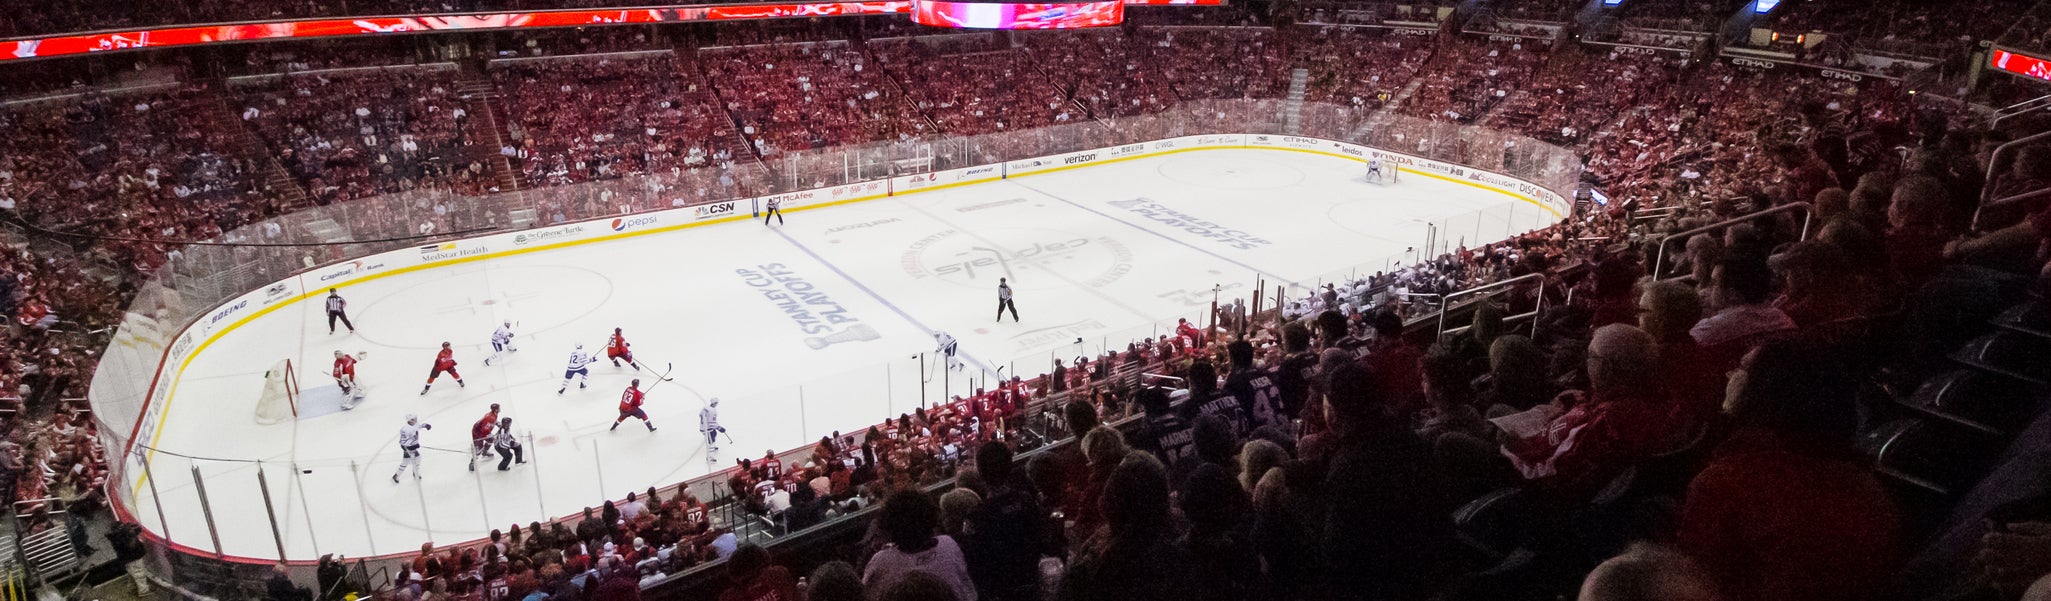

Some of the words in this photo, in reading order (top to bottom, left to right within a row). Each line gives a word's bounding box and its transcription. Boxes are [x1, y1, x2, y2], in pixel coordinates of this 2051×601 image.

[1731, 57, 1775, 69] ETIHAD
[1820, 69, 1862, 82] ETIHAD
[1283, 136, 1318, 145] ETIHAD
[1342, 145, 1363, 157] leidos
[1064, 153, 1096, 165] verizon
[1379, 152, 1414, 166] ONDA
[782, 191, 814, 202] McAfee
[1519, 183, 1554, 202] DISCOVER
[709, 202, 735, 214] CSN
[627, 215, 657, 229] pepsi
[1128, 208, 1259, 250] PLAYOFFS
[1141, 203, 1227, 230] STANLEY
[1222, 229, 1273, 245] CUP
[320, 267, 352, 282] Capital
[735, 268, 774, 288] CUP
[757, 262, 860, 325] PLAYOFFS
[211, 299, 248, 324] BOEING
[758, 288, 834, 335] STANLEY
[569, 354, 578, 364] 12
